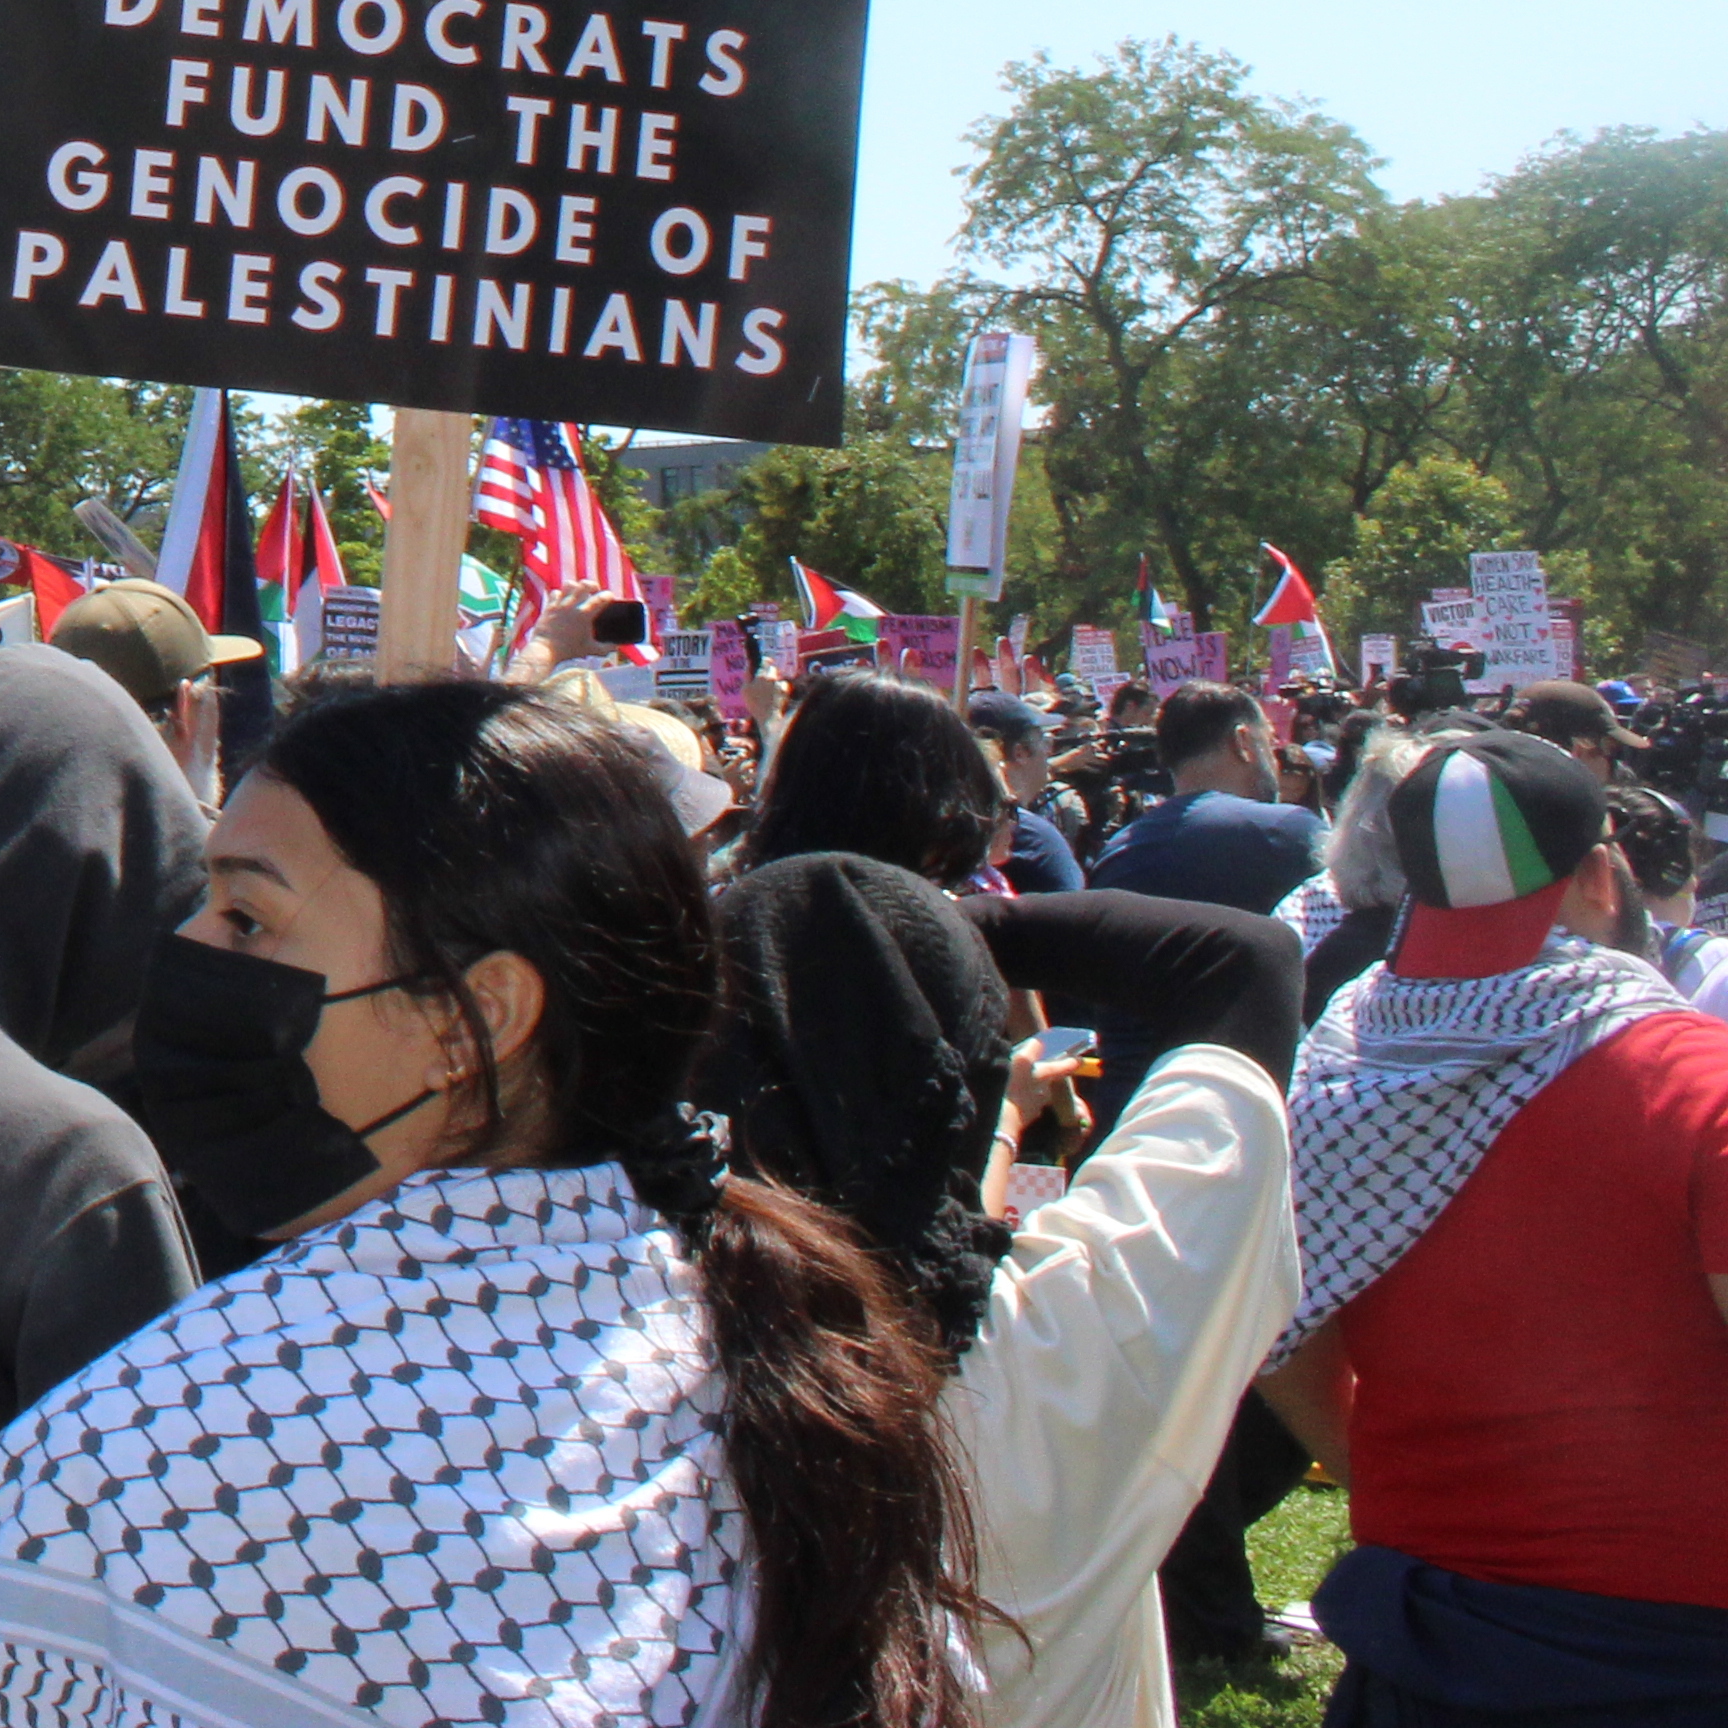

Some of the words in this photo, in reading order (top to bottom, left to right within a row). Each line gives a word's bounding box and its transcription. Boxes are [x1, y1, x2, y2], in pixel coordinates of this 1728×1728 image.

[166, 58, 446, 154] FUND
[506, 96, 680, 183] THE
[46, 140, 598, 266] GENOCIDE
[650, 207, 773, 282] OF
[11, 230, 786, 378] PALESTINIANS
[1474, 575, 1540, 592] HEALTH-
[1486, 596, 1532, 616] CARE
[326, 614, 378, 630] LEGAC
[327, 633, 345, 643] THE
[1495, 623, 1530, 641] NOT
[326, 647, 346, 658] OF
